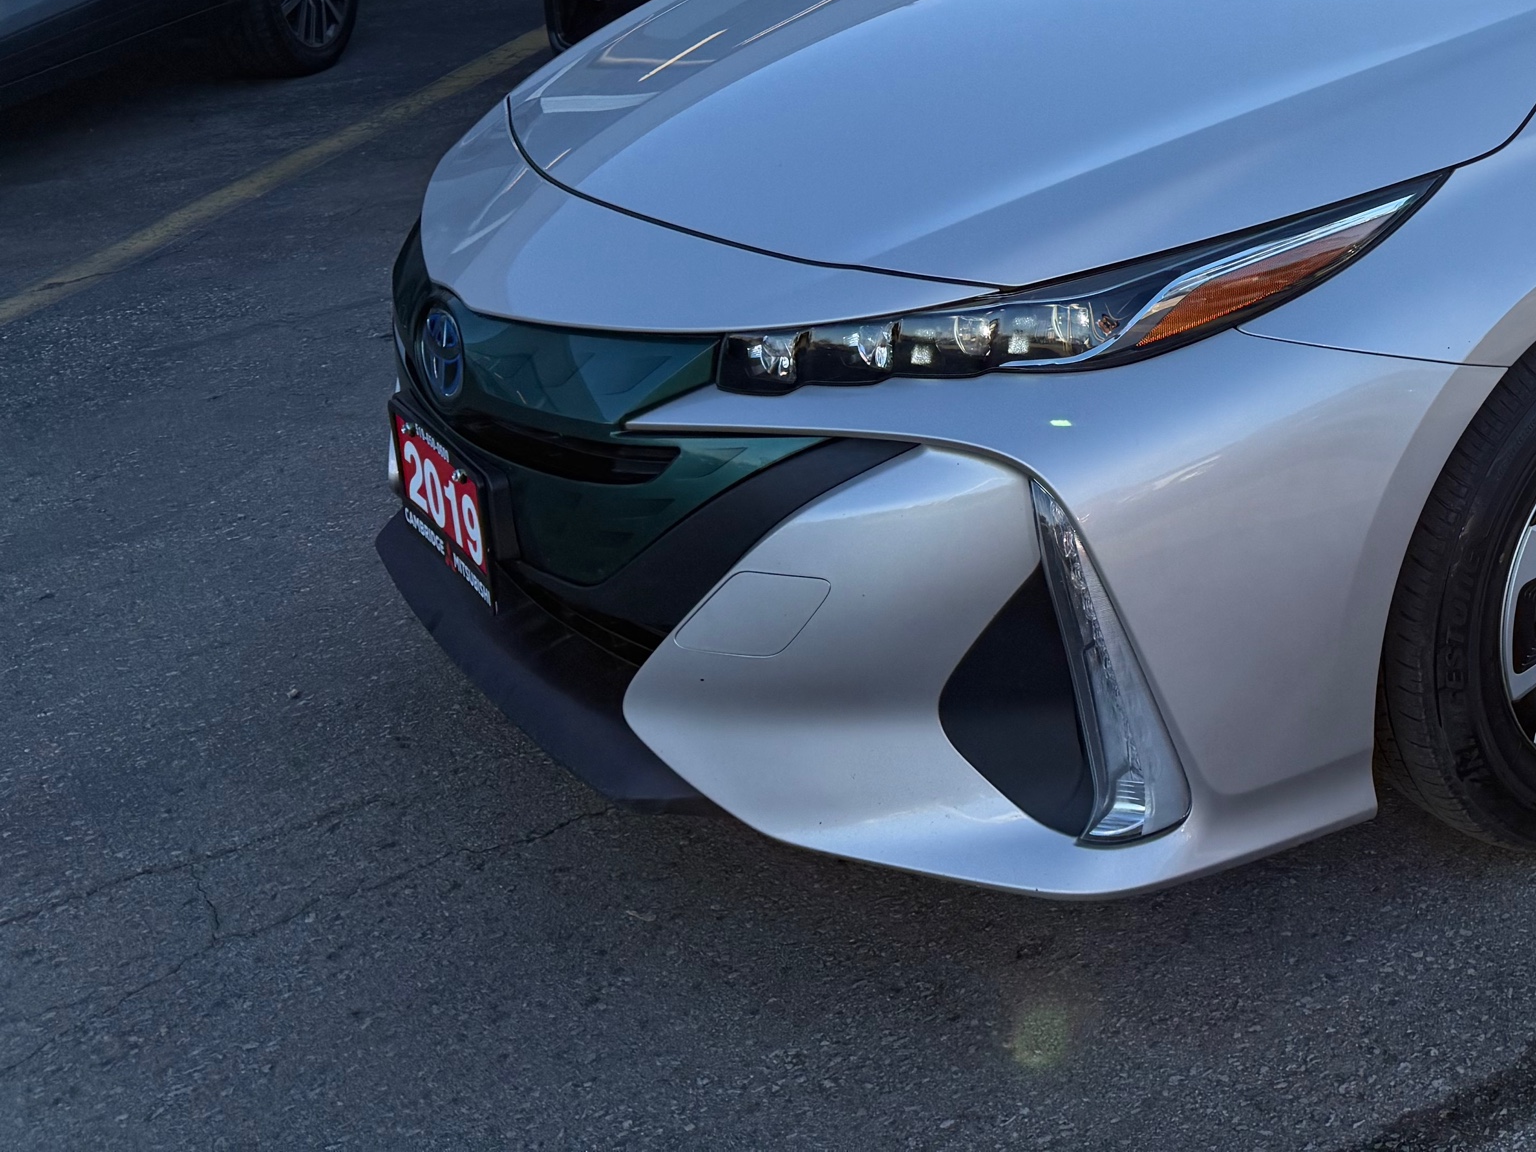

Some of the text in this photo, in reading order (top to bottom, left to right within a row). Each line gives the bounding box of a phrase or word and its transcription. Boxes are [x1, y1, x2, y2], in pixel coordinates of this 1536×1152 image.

[403, 440, 484, 566] 2019
[404, 507, 446, 556] CAMBRIDGE
[453, 552, 492, 607] MITSUBISHI
